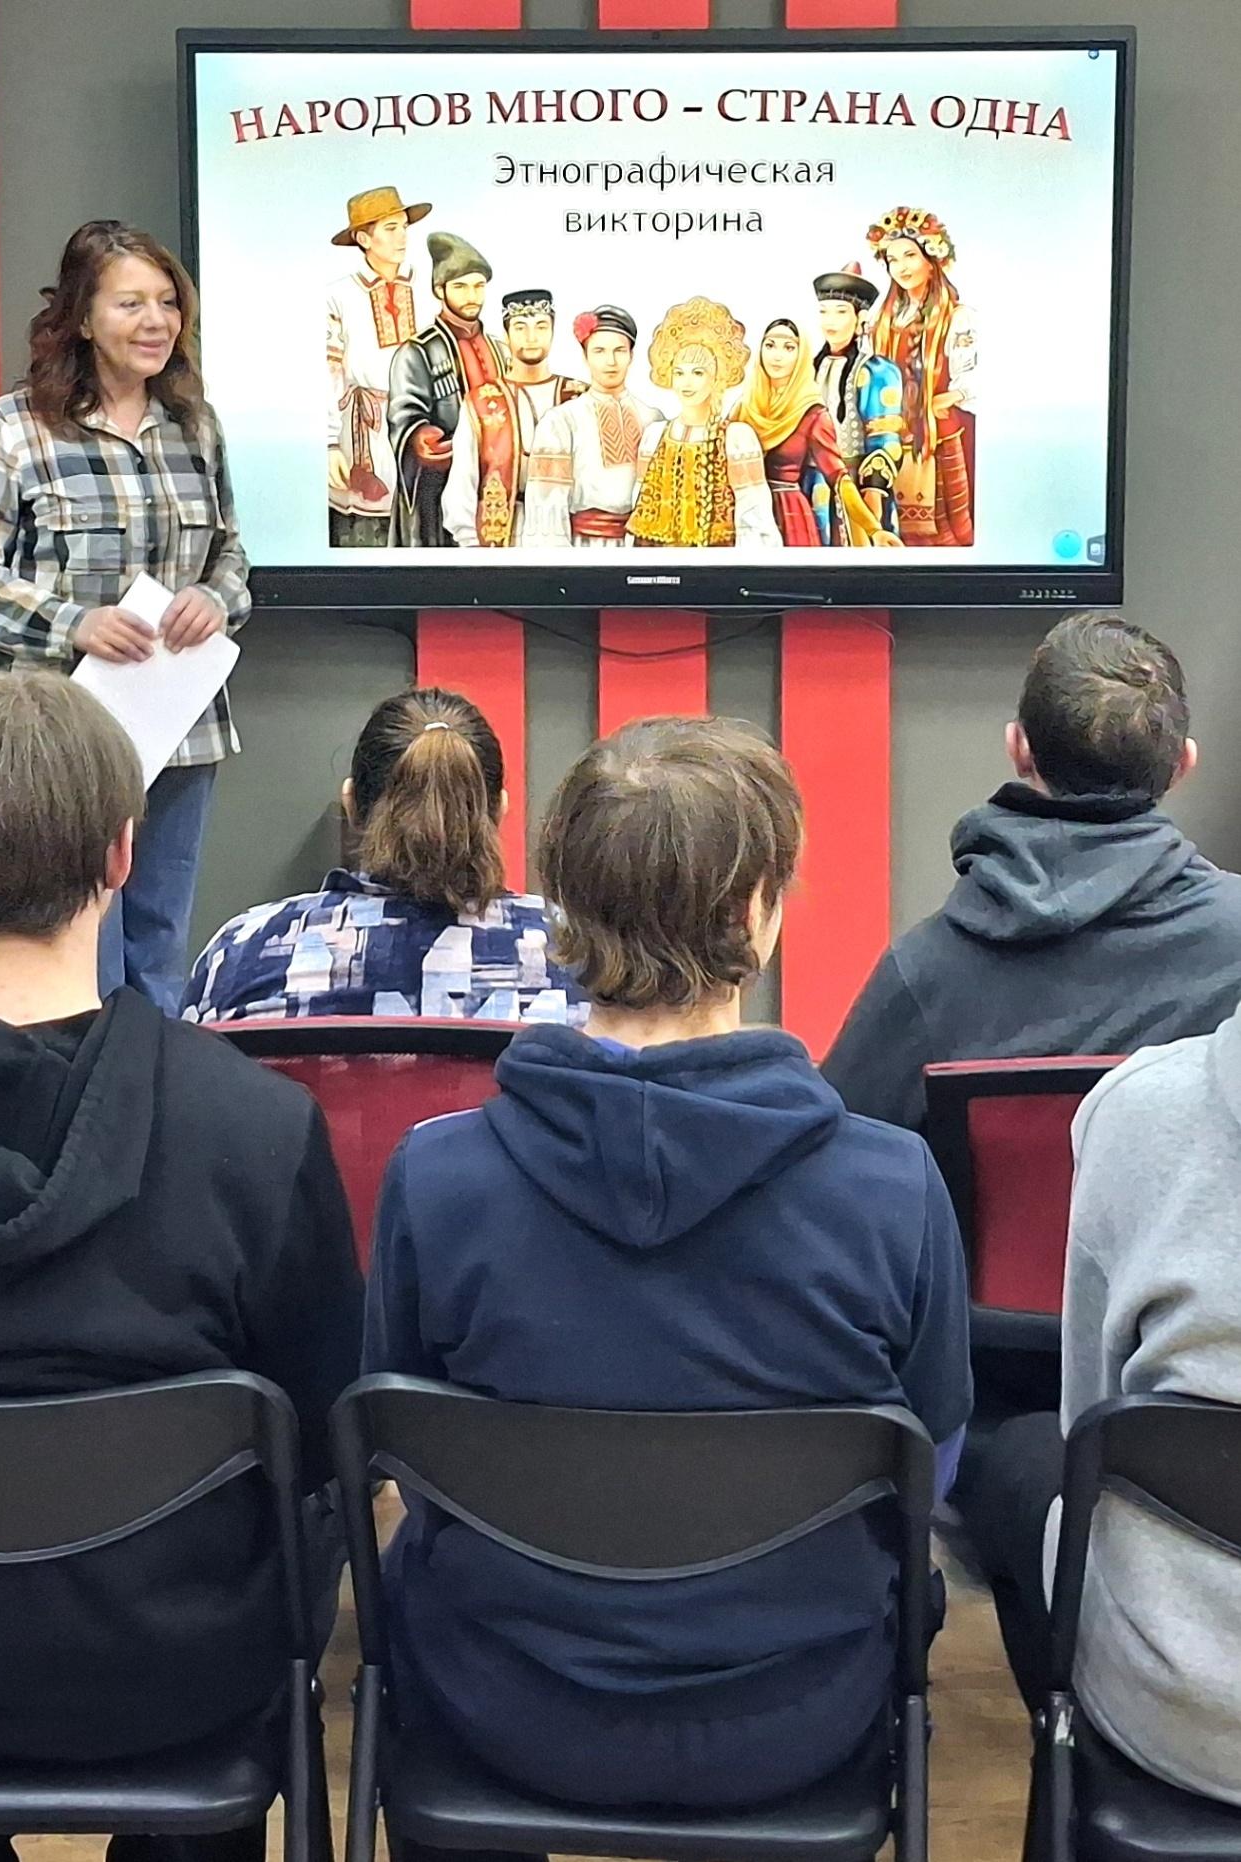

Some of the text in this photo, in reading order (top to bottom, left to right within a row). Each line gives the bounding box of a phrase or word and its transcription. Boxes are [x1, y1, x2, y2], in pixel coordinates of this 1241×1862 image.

[230, 92, 472, 143] НАРОДОВ
[486, 88, 669, 125] МНОГО
[717, 88, 916, 126] СТРАНА
[930, 95, 1073, 141] ОДНА
[494, 152, 835, 191] Этнографическая
[565, 209, 763, 241] викторина
